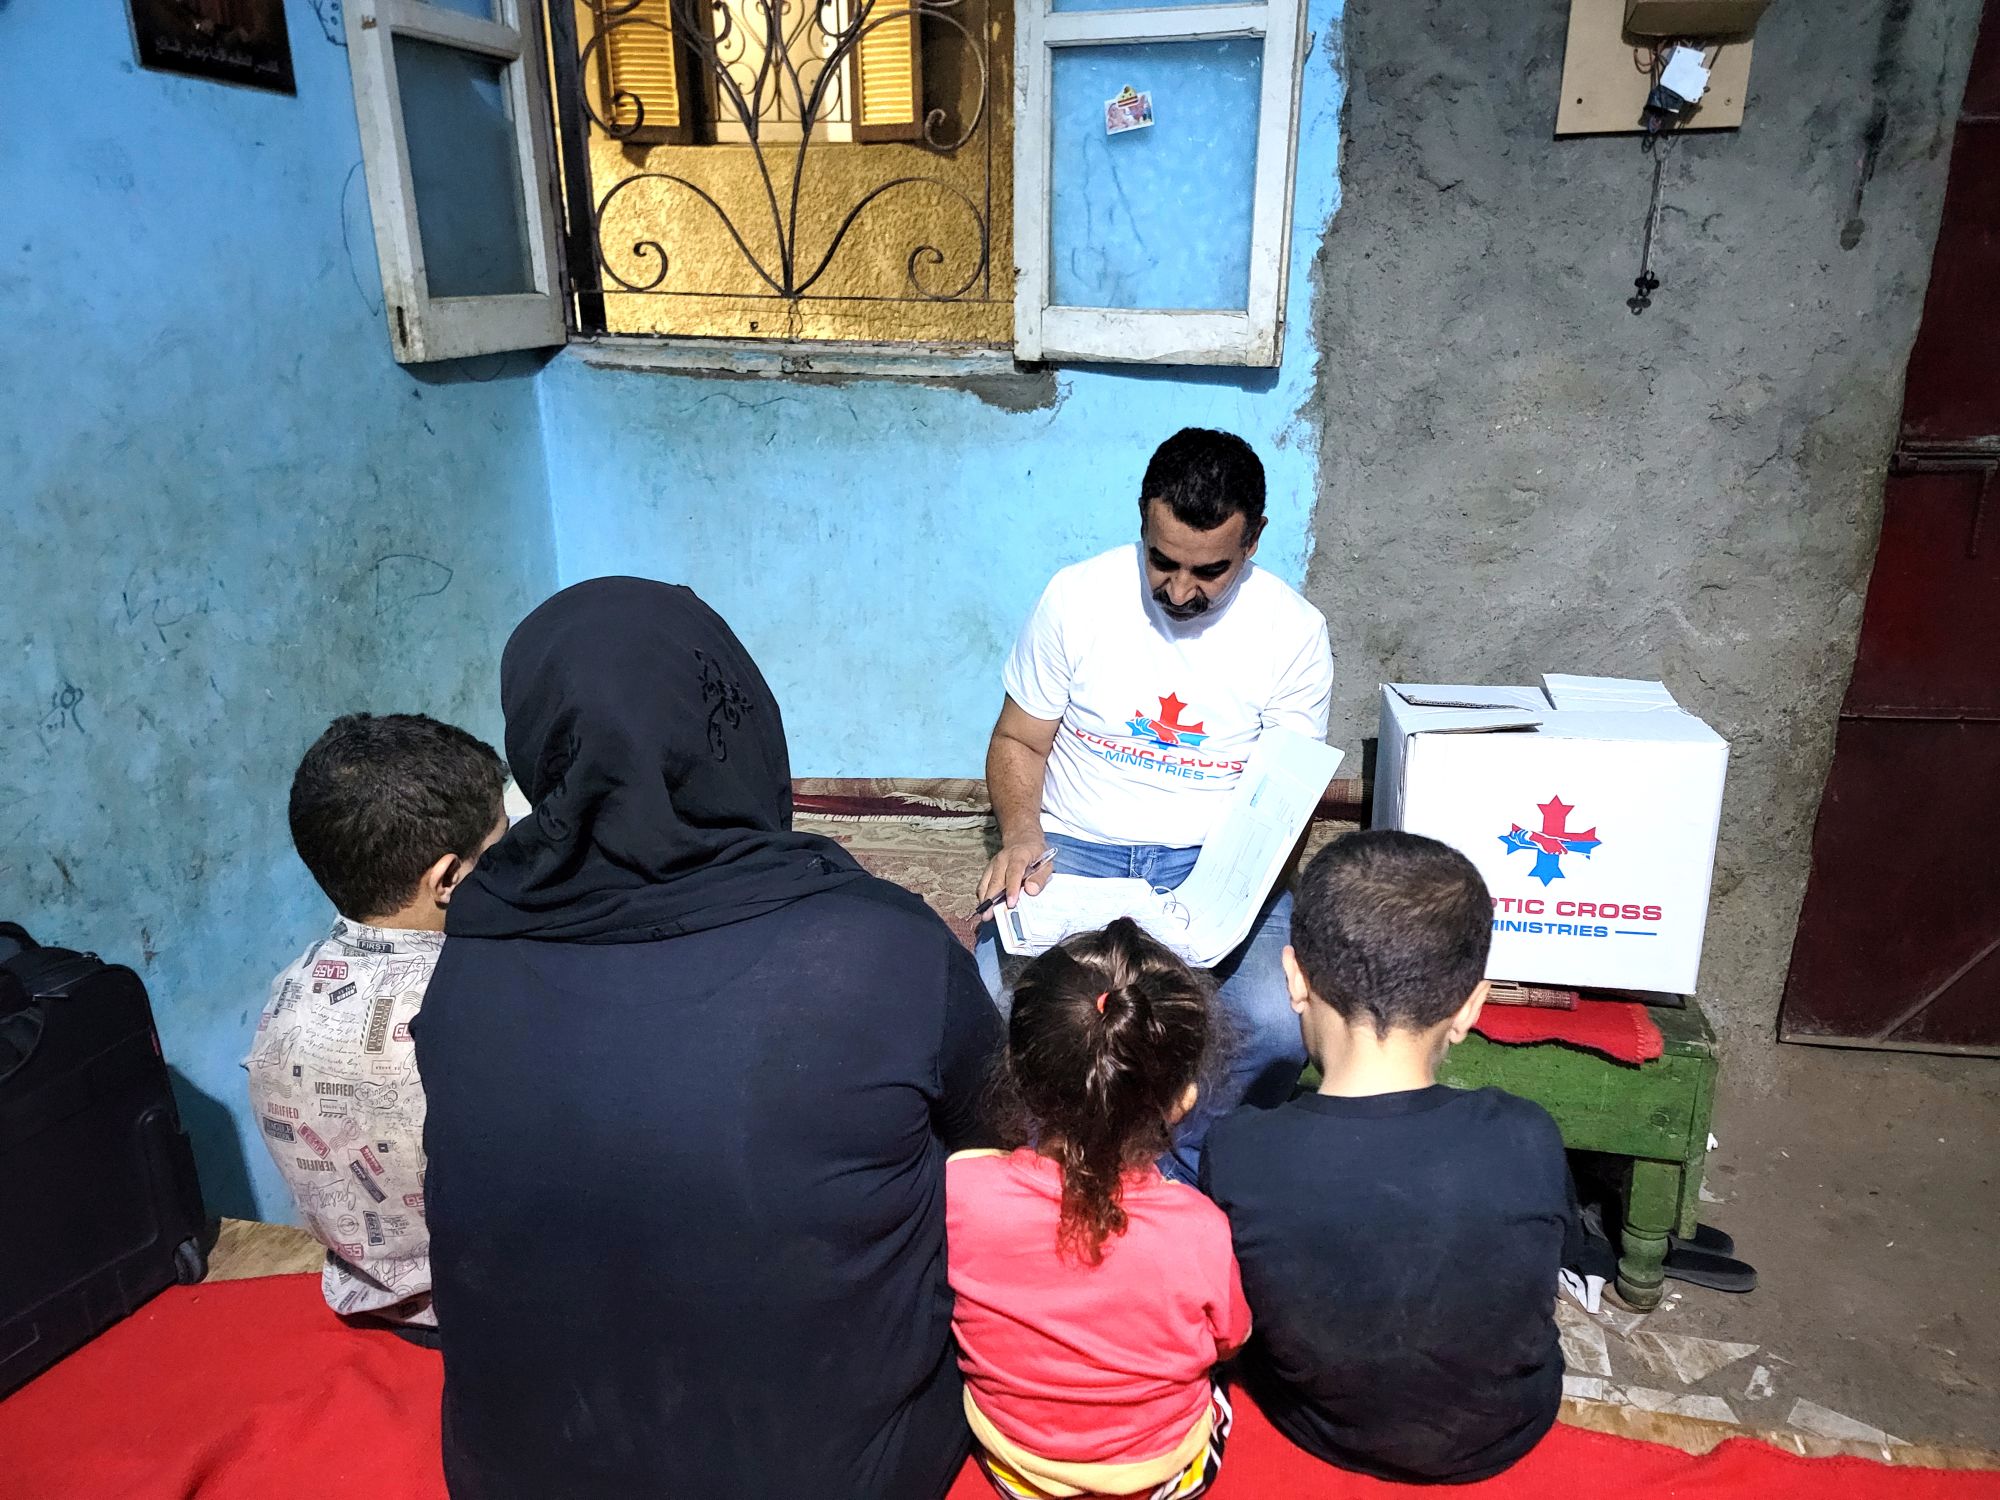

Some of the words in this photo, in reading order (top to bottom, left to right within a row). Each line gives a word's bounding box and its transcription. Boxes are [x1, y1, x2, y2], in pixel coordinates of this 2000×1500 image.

[1104, 750, 1204, 781] MINISTRIES
[1491, 897, 1545, 915] TIC
[1556, 901, 1662, 921] CROSS
[361, 942, 387, 951] FIRST
[313, 964, 347, 979] GLASS
[314, 1081, 355, 1097] VERIFIED
[267, 1101, 299, 1119] VERIFIED
[296, 1158, 337, 1172] VERIFIED
